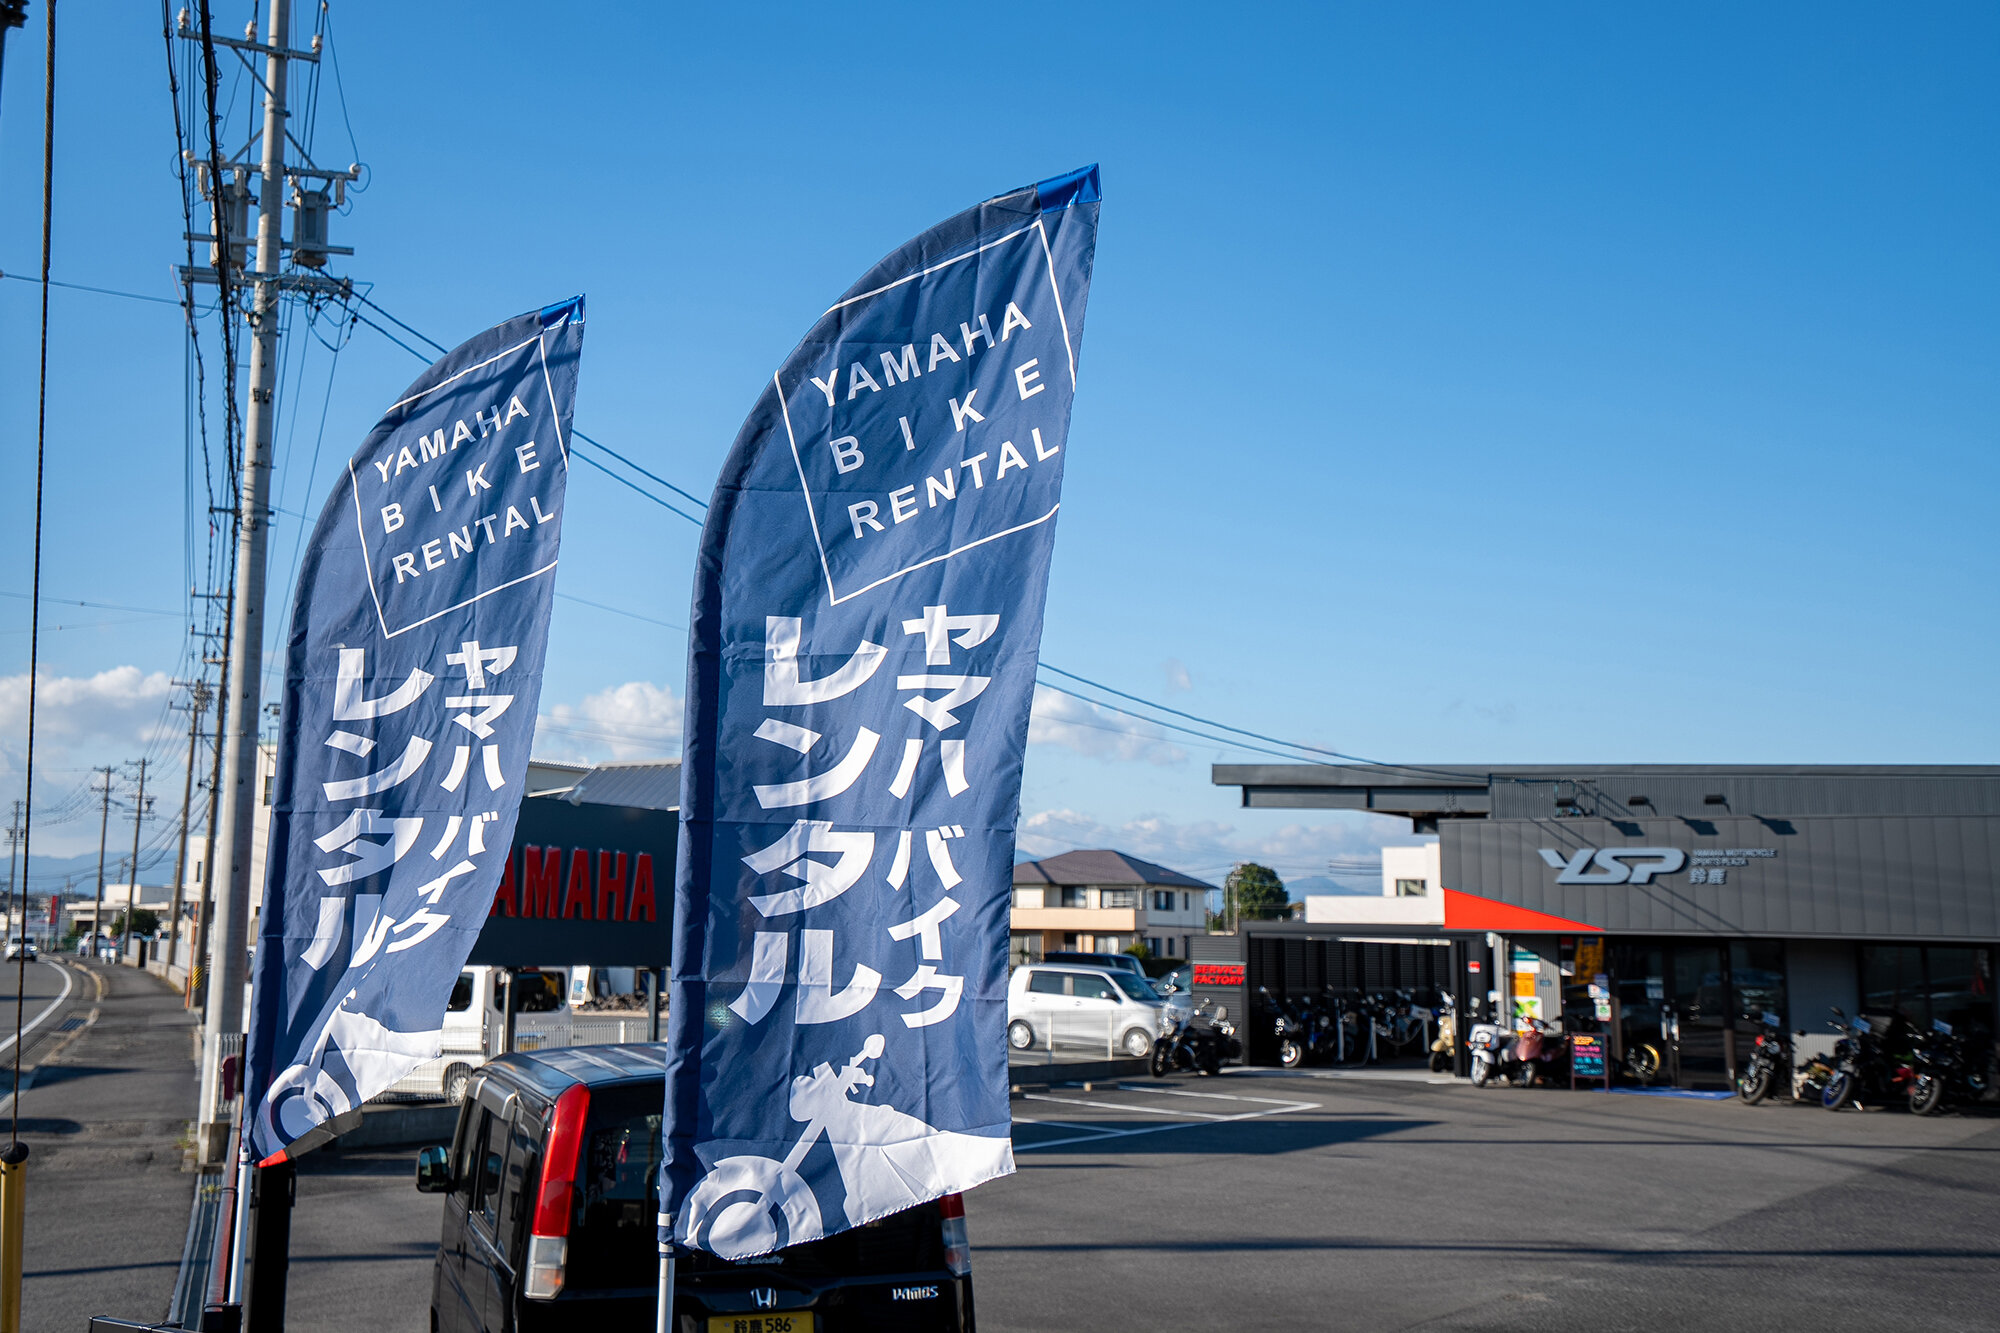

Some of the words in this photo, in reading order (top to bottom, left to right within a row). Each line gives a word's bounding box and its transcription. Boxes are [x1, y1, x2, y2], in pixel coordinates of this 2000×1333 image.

[810, 301, 1032, 407] YAMAHA
[374, 395, 529, 483] YAMAHA
[829, 358, 1045, 475] BIKE
[380, 440, 540, 534] BIKE
[848, 427, 1059, 539] RENTAL
[391, 496, 554, 584] RENTAL
[300, 648, 435, 971] レンタル
[728, 615, 889, 1026] レンタル
[489, 845, 657, 922] AMAHA
[1538, 847, 1685, 884] YSP
[1193, 975, 1246, 985] FACTORY
[1194, 964, 1245, 975] SERVICE
[765, 1318, 792, 1333] 586
